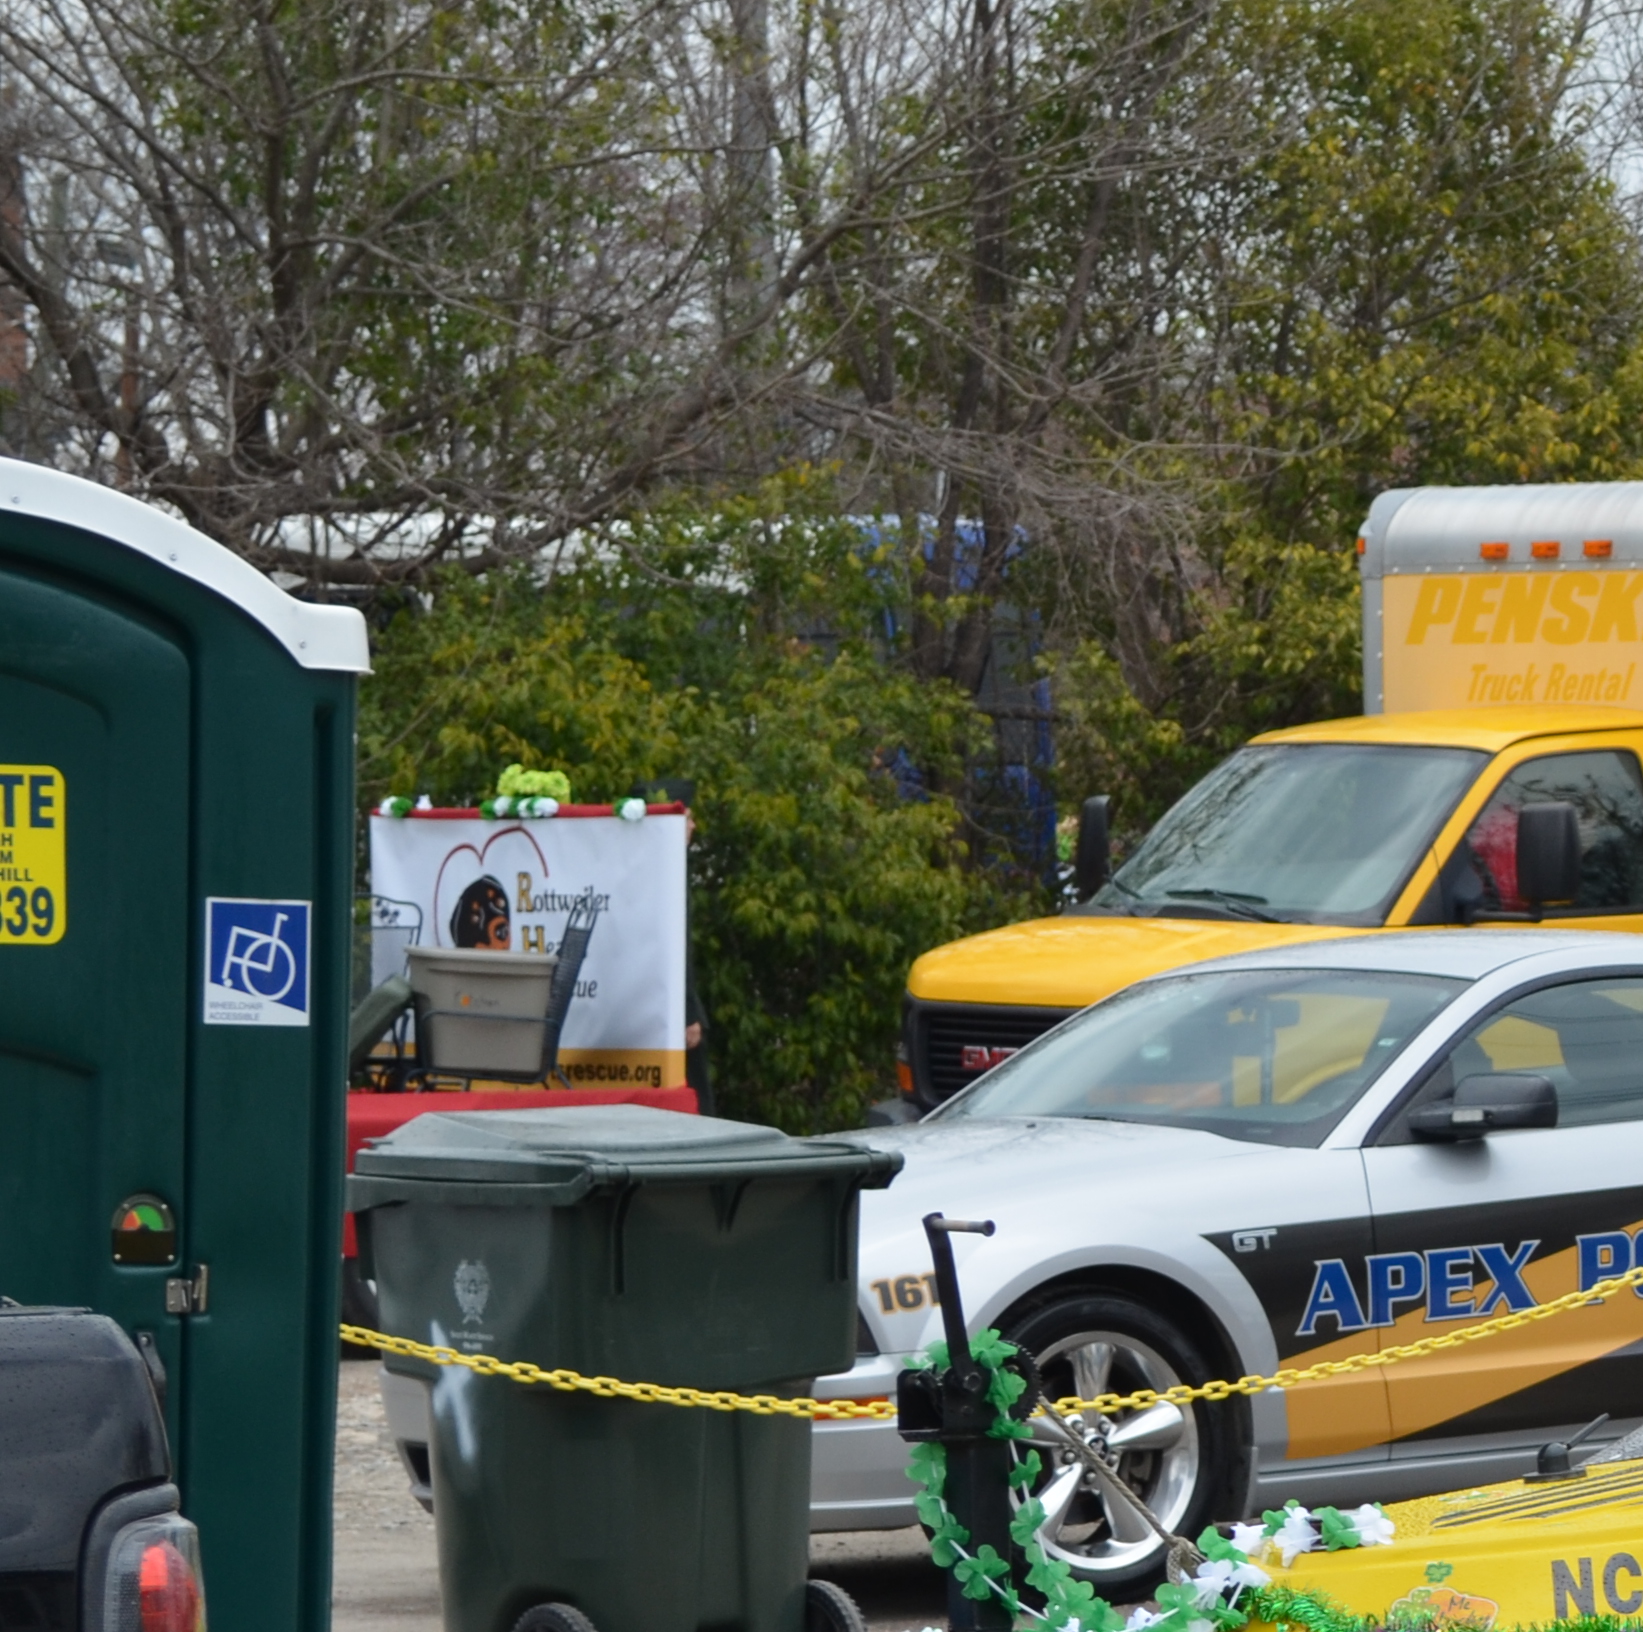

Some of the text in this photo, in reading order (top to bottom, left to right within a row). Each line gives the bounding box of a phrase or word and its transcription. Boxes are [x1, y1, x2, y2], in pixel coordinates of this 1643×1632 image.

[1466, 661, 1637, 702] Truck Rental
[208, 1001, 263, 1010] WHEELCHAIR
[209, 1011, 260, 1021] ACCESSIBLE
[1232, 1228, 1278, 1252] GT
[1295, 1238, 1541, 1336] APEX
